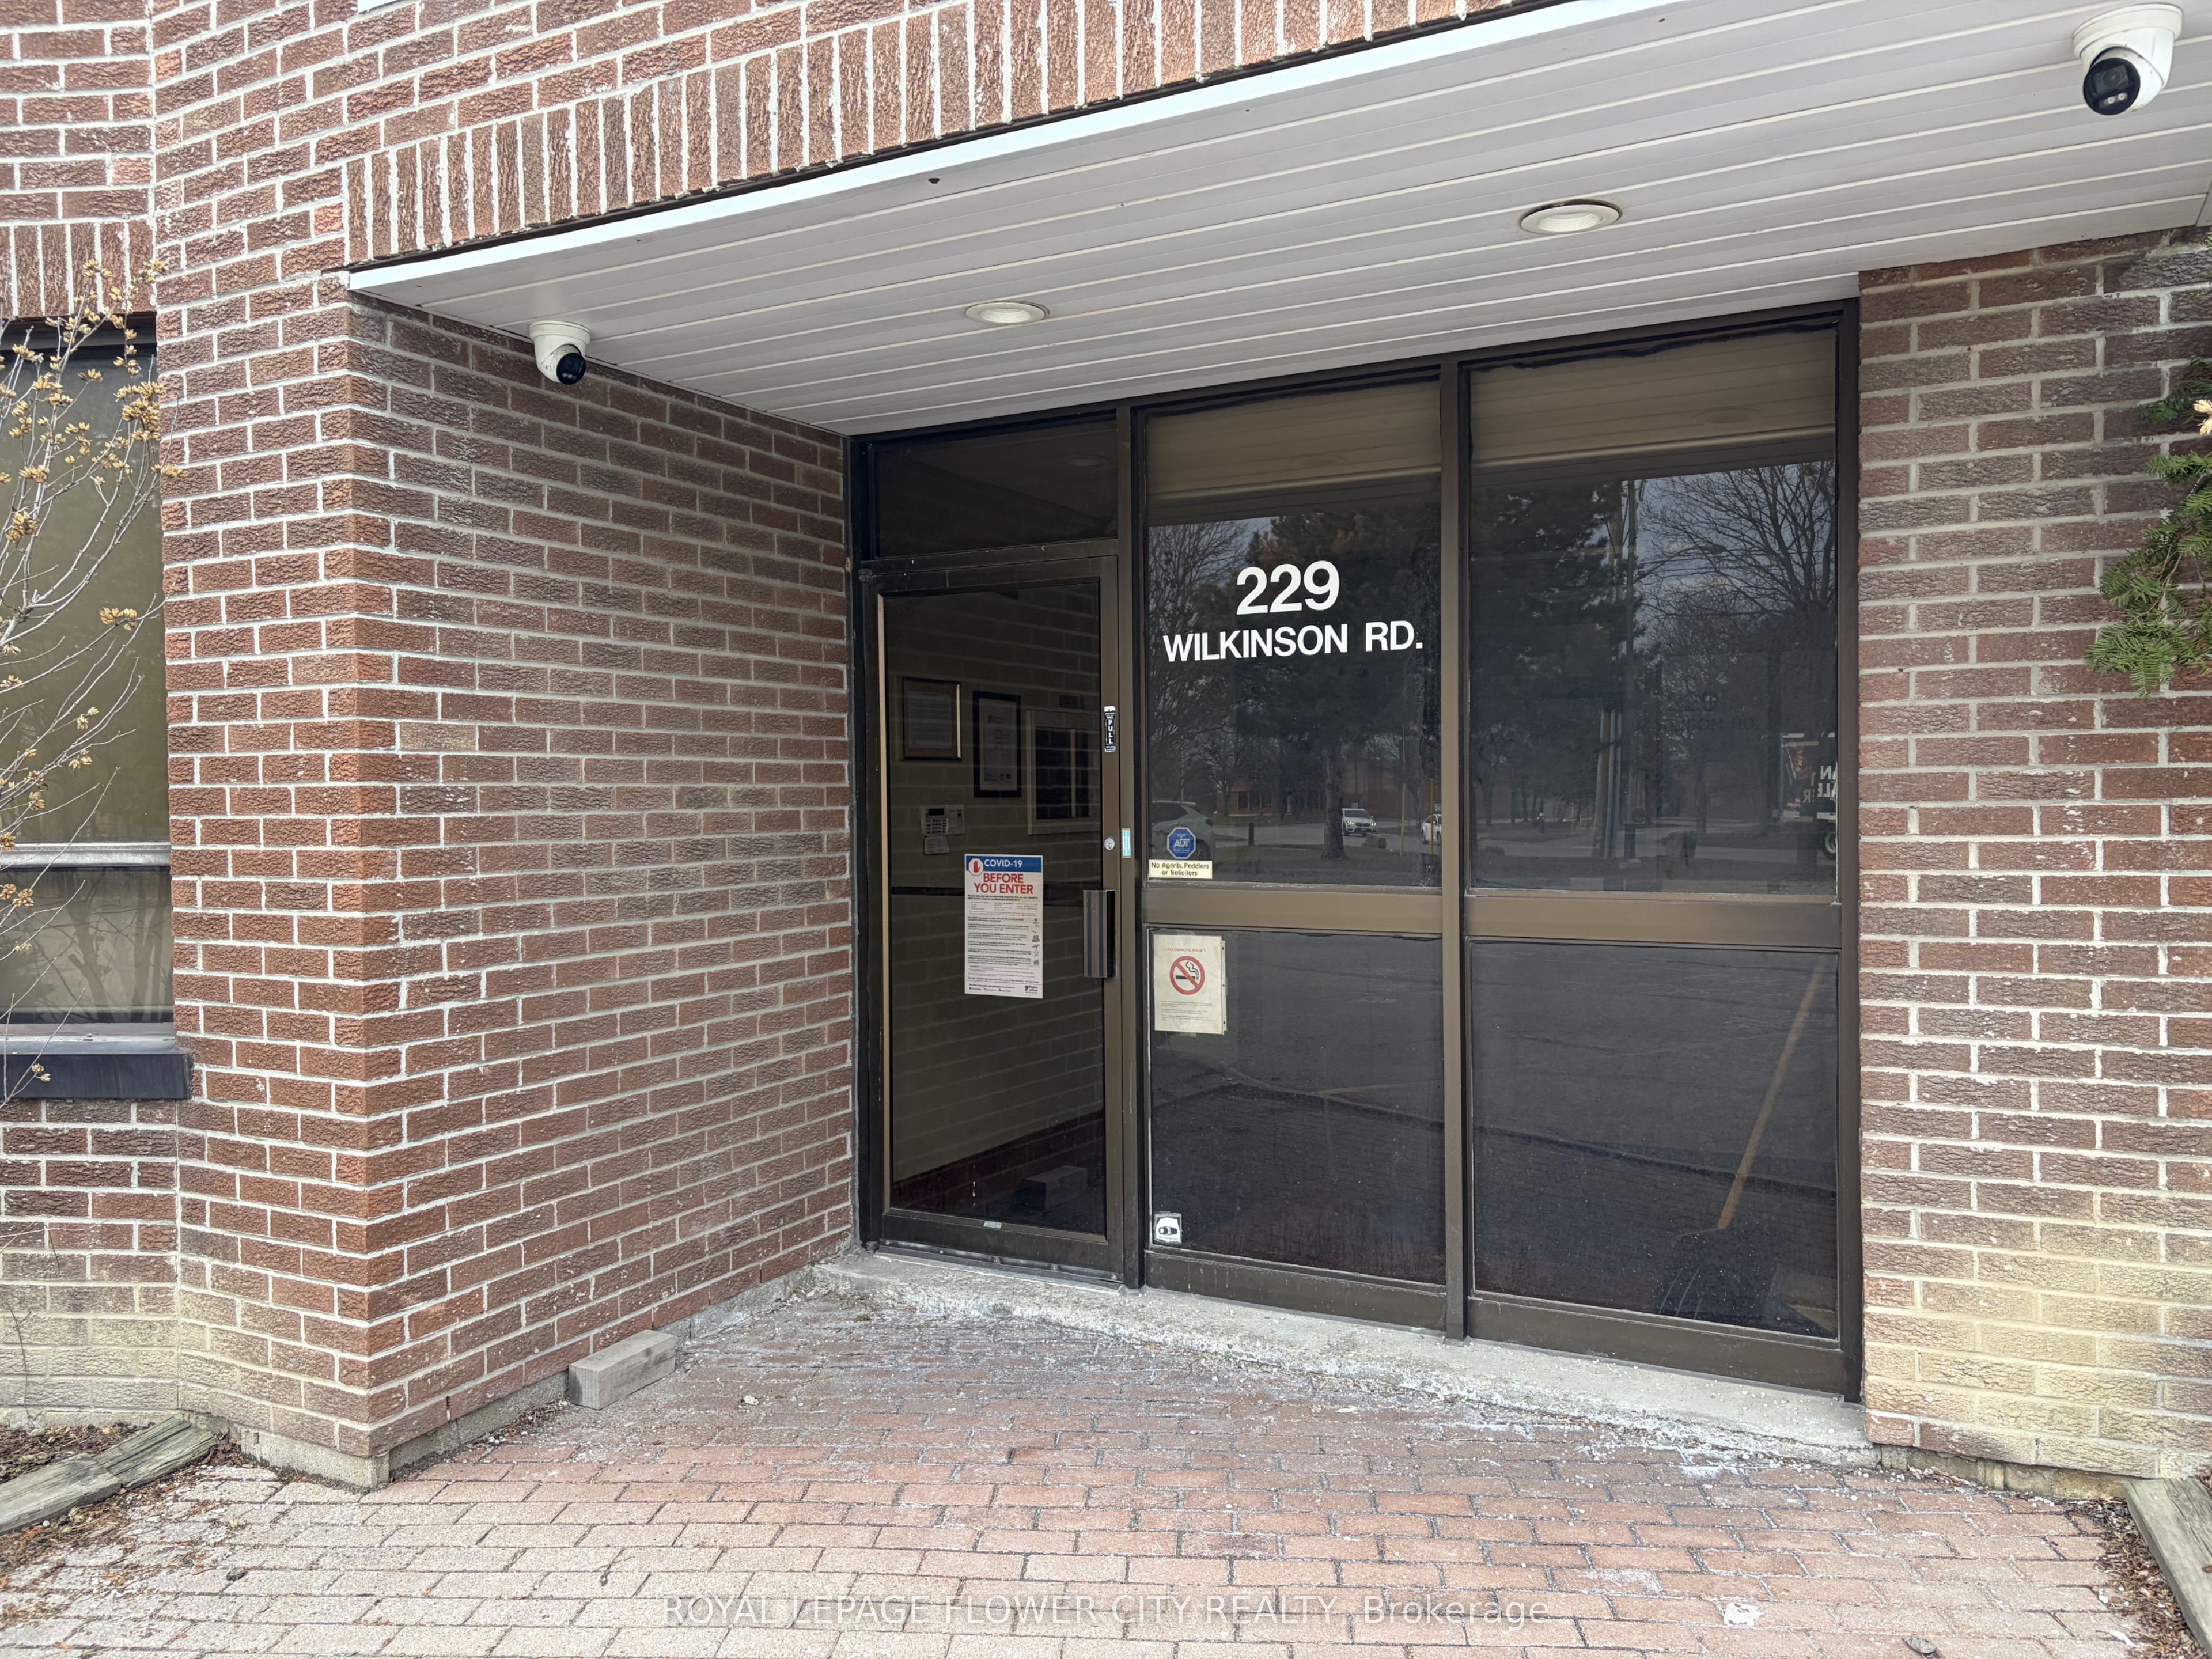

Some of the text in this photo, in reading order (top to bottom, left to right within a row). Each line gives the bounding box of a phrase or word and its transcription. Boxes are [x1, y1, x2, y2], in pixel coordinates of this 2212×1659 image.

[1236, 560, 1340, 615] 229
[1162, 619, 1423, 662] WILKINSON RD.
[1173, 838, 1190, 847] ADT
[984, 859, 1022, 868] COVID-19
[983, 873, 1024, 884] BEFORE
[974, 882, 1034, 895] YOU ENTER
